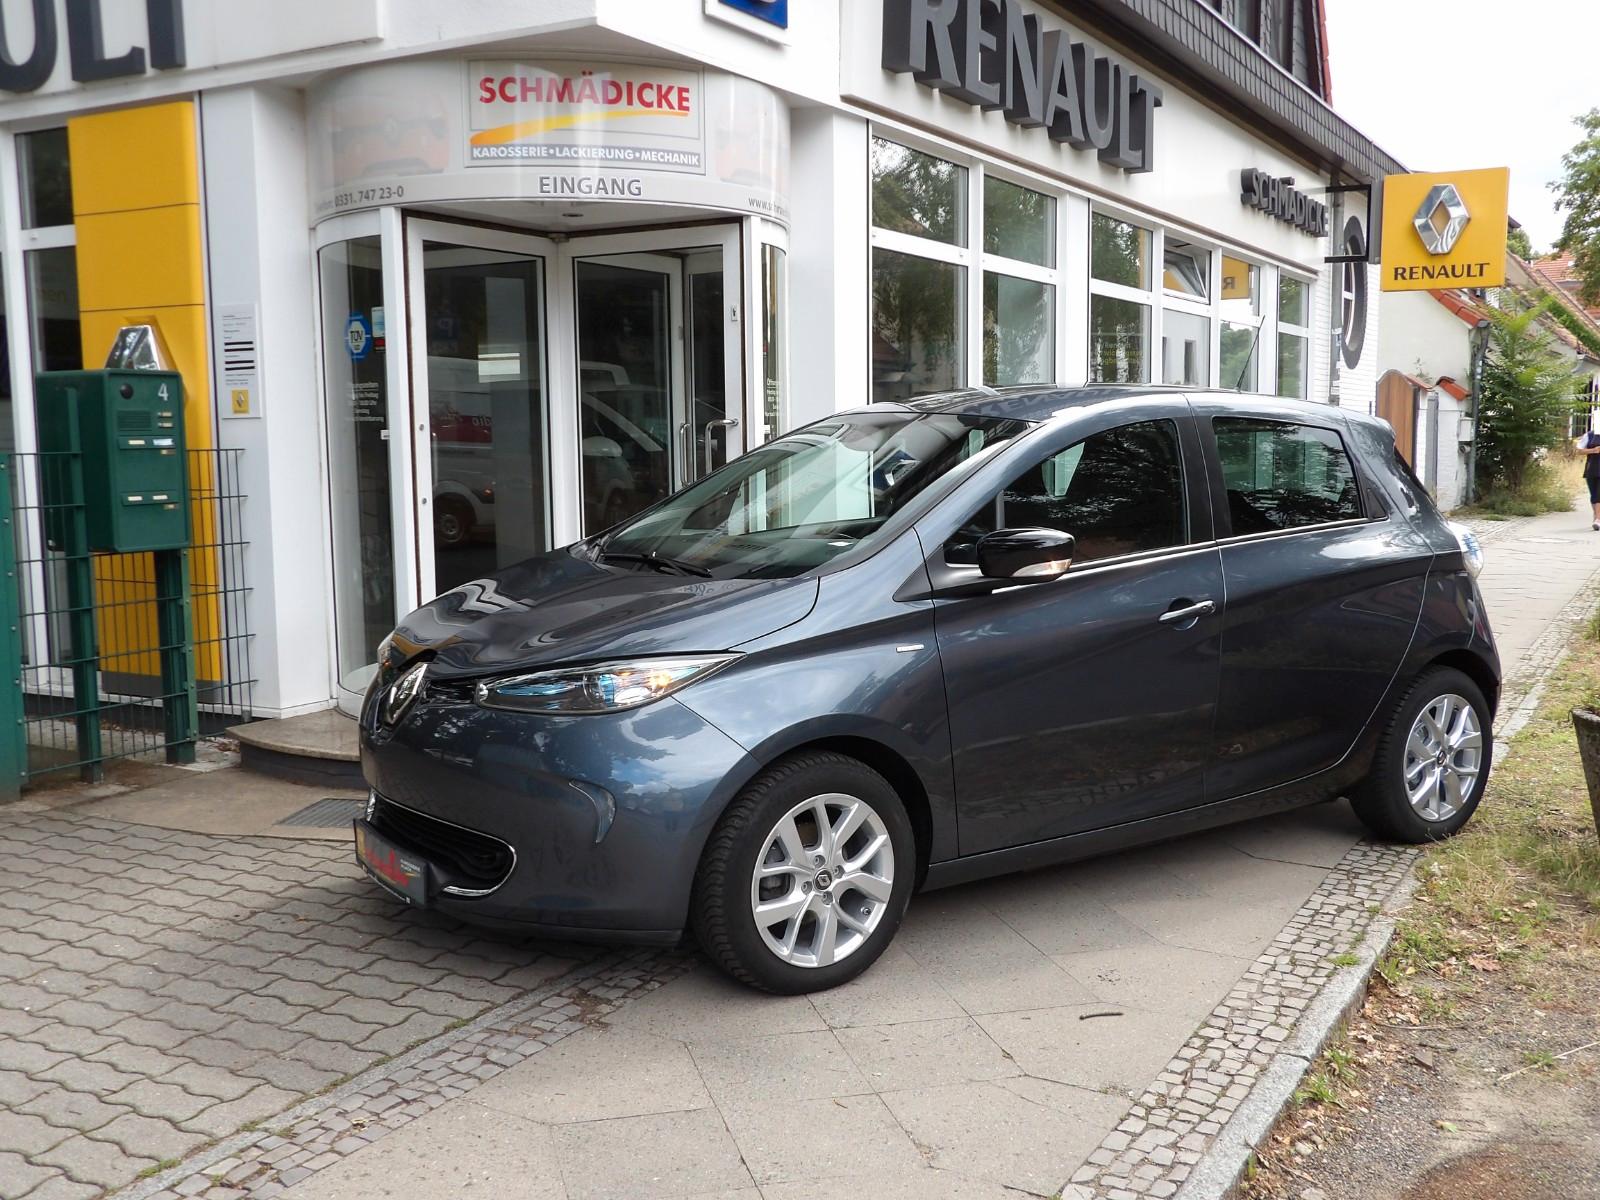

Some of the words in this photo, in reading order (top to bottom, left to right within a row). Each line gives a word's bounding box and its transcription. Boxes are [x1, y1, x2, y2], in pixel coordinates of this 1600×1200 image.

[479, 71, 690, 112] SCHMÄDICKE
[882, 0, 1163, 173] RENAULT
[379, 185, 404, 199] 23-0
[538, 176, 642, 197] EINGANG
[1241, 168, 1329, 237] SCHMÄDICKE
[1393, 263, 1490, 281] RENAULT
[158, 383, 168, 401] 4
